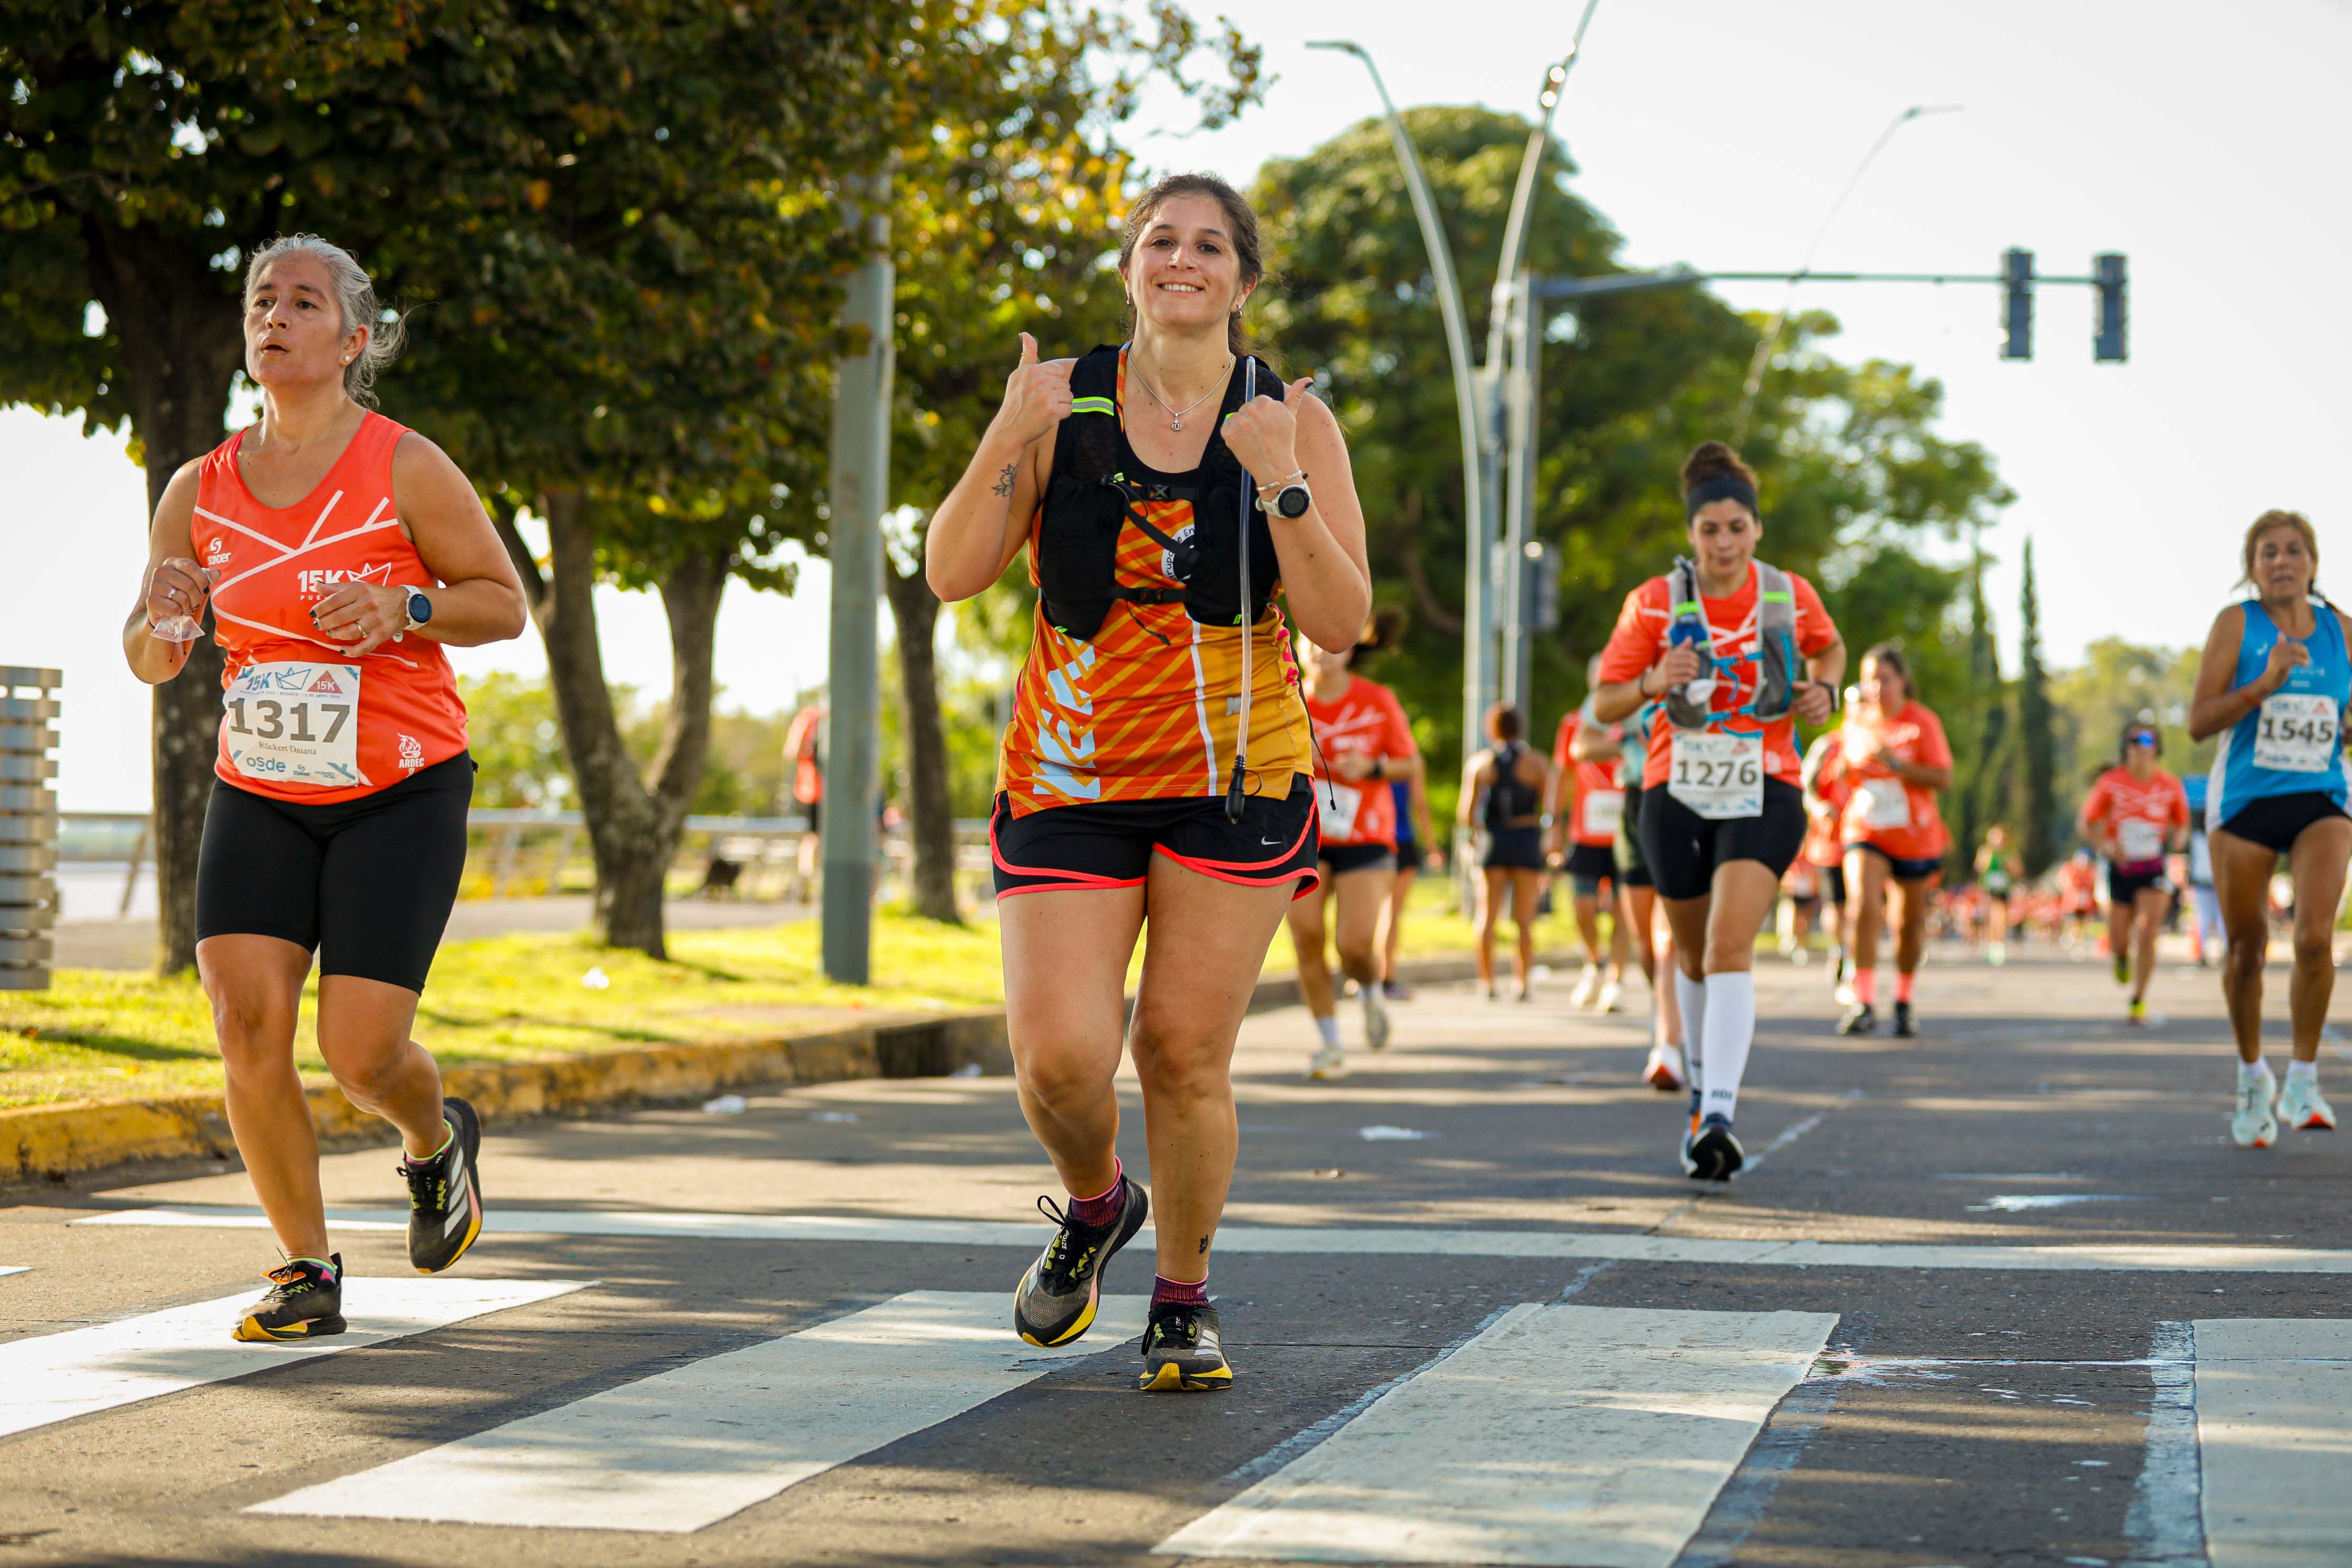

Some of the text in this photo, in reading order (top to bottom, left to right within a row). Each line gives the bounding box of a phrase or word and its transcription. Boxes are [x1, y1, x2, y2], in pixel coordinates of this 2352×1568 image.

[298, 570, 345, 592] 15K
[246, 672, 272, 690] 15K
[316, 680, 336, 691] 15K
[228, 697, 350, 743] 1317
[2262, 718, 2334, 744] 1545
[259, 741, 317, 754] Rückert Daiana
[246, 757, 286, 773] osde
[399, 758, 425, 768] ARDEC
[1675, 759, 1758, 787] 1276
[1059, 1229, 1070, 1260] ADIZEO
